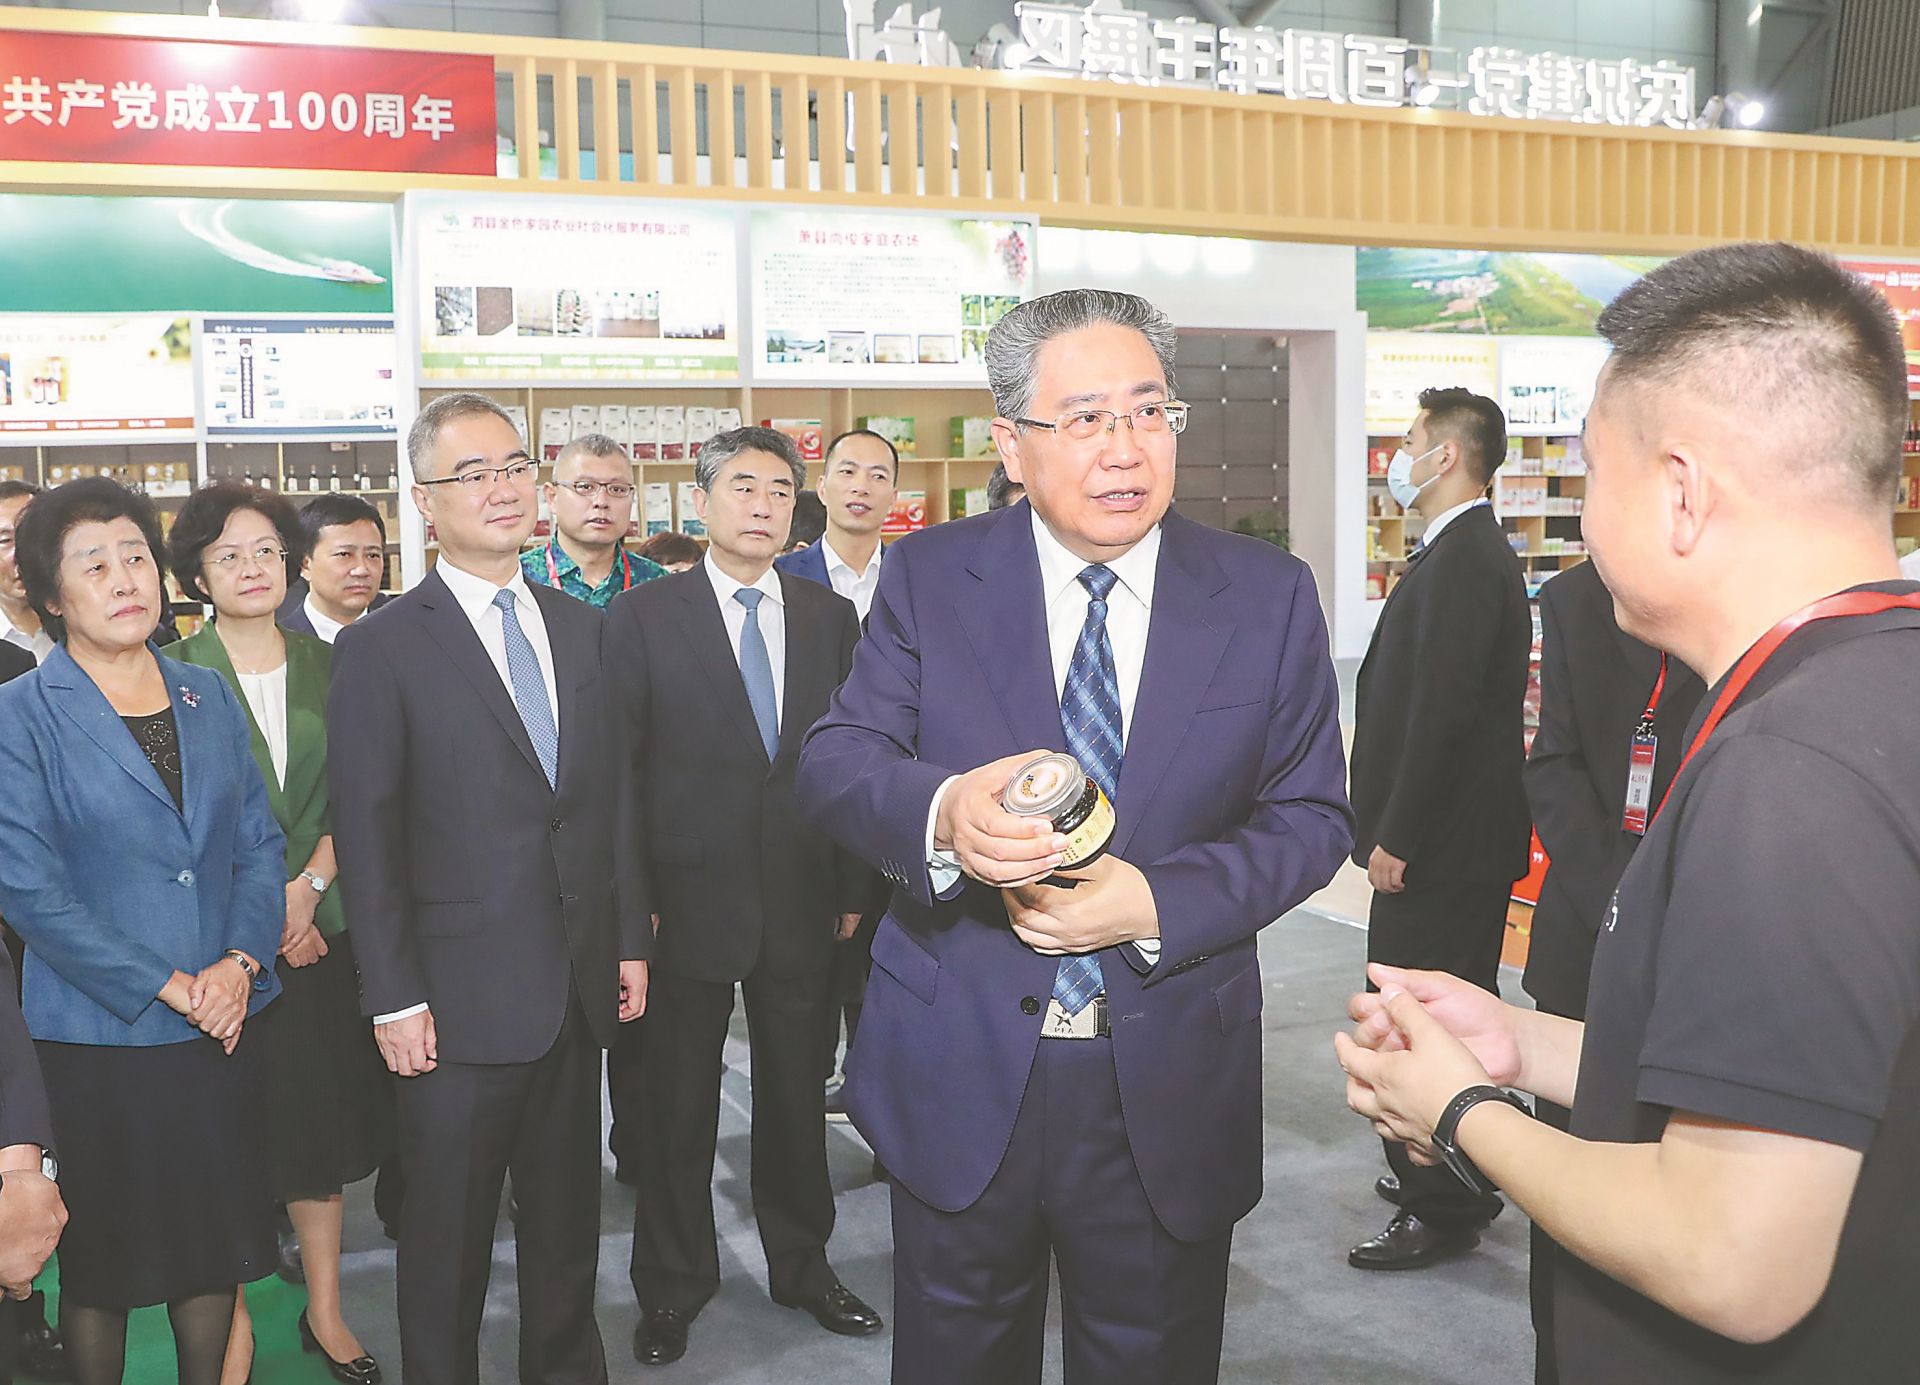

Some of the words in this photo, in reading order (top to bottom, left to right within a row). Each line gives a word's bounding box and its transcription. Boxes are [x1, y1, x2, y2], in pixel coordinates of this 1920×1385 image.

[3, 75, 455, 141] 共产党成立100周年
